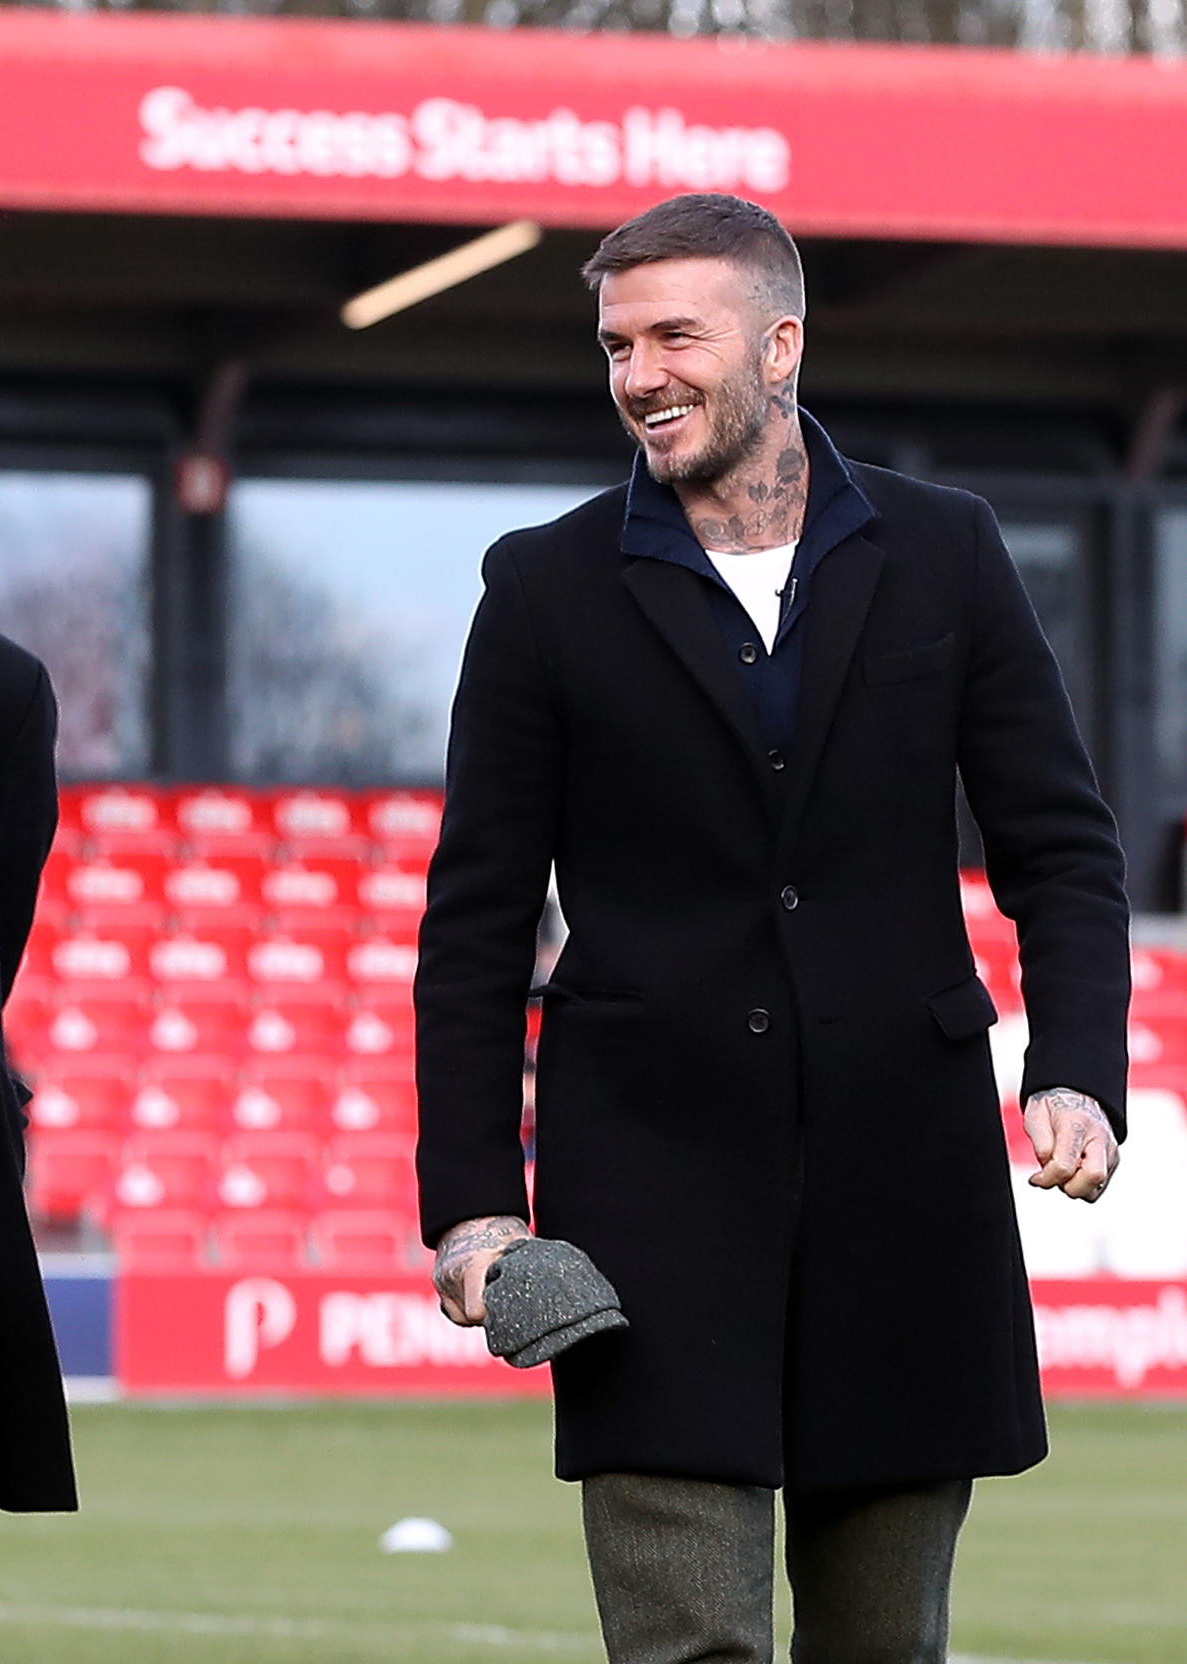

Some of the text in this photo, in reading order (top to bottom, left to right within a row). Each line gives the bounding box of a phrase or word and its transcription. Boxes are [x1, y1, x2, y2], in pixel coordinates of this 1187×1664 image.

[139, 86, 790, 192] Success Starts Here
